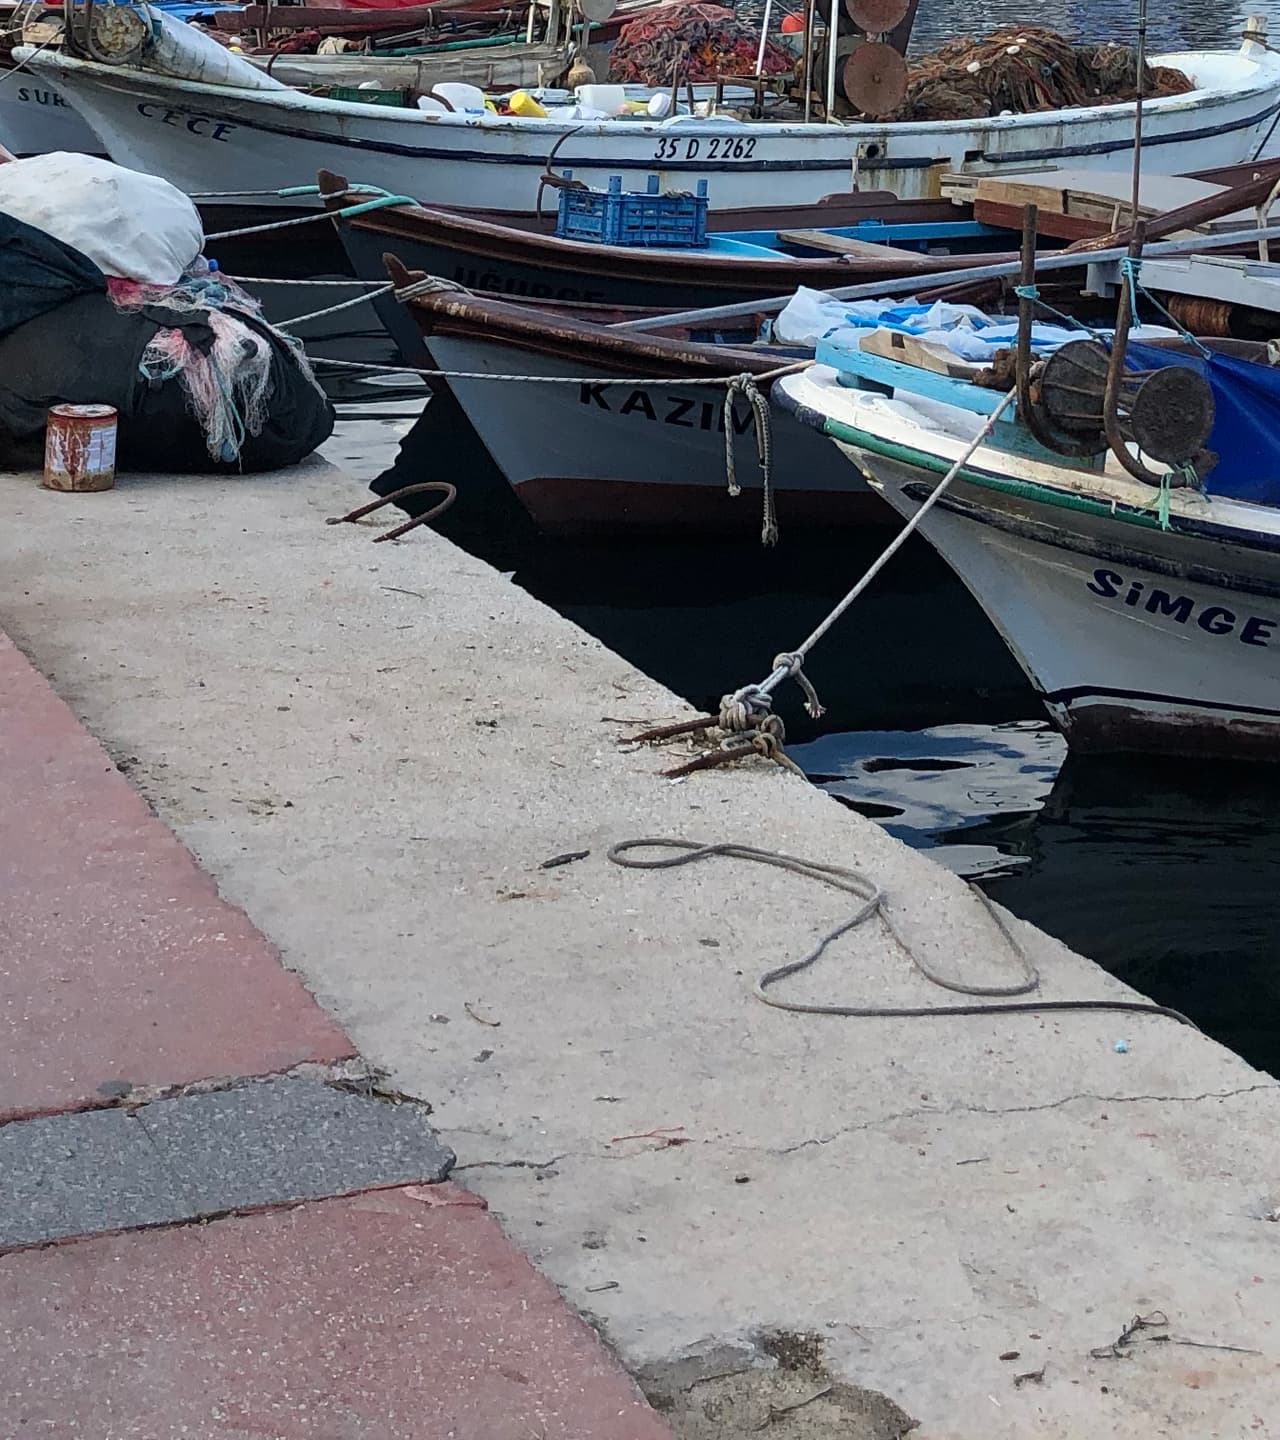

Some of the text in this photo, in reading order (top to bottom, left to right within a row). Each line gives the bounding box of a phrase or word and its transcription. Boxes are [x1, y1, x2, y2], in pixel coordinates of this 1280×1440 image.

[654, 137, 756, 160] 35 D 2262
